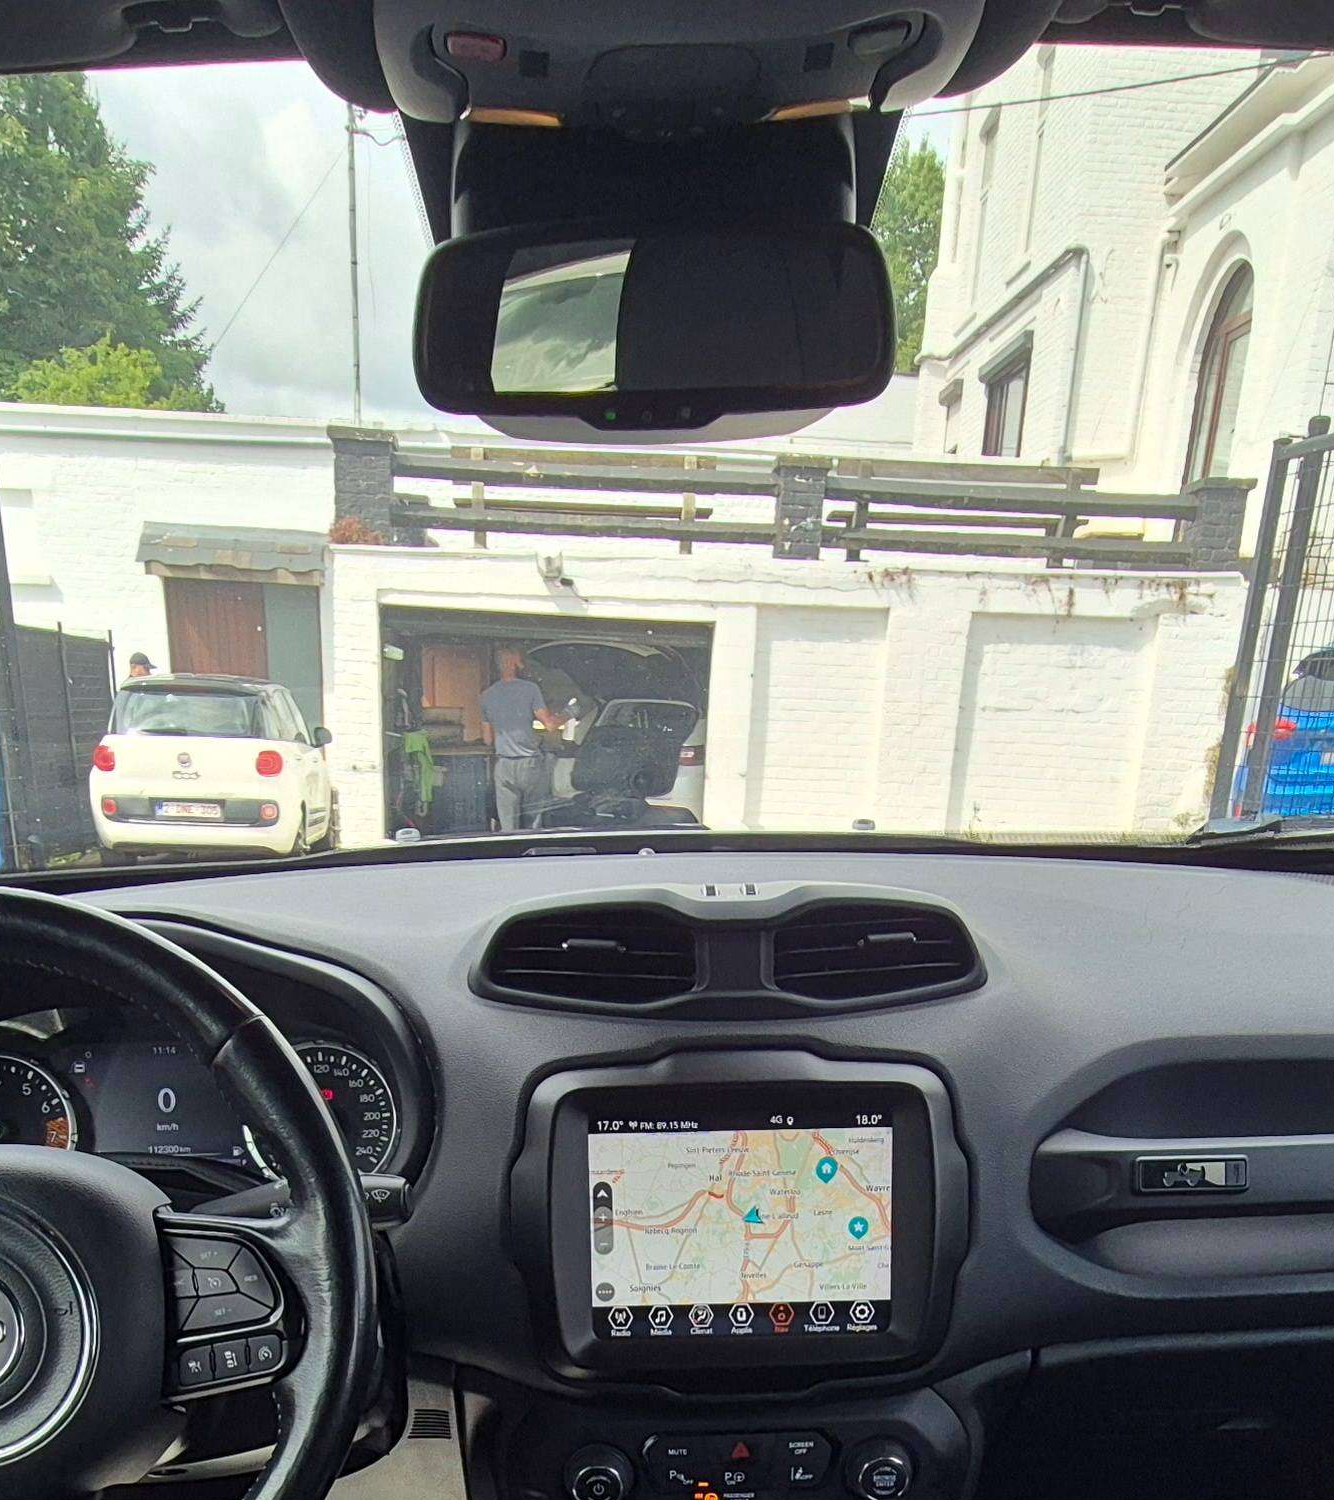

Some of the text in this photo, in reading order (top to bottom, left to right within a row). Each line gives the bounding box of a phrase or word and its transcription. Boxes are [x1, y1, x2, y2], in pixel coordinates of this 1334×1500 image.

[153, 1047, 176, 1055] 11:14
[313, 1064, 329, 1073] 120
[333, 1068, 349, 1076] 140
[348, 1079, 363, 1088] 160
[22, 1083, 32, 1096] 5
[157, 1087, 176, 1113] 0
[359, 1094, 375, 1102] 180
[41, 1101, 51, 1113] 6
[363, 1112, 380, 1121] 200
[770, 1115, 783, 1124] 4G
[156, 1123, 179, 1131] km/h
[680, 1120, 699, 1129] MHz
[47, 1131, 57, 1143] 7
[362, 1129, 380, 1138] 220
[355, 1146, 373, 1156] 240
[709, 1174, 723, 1182] Hal
[788, 1441, 814, 1449] SCREEN
